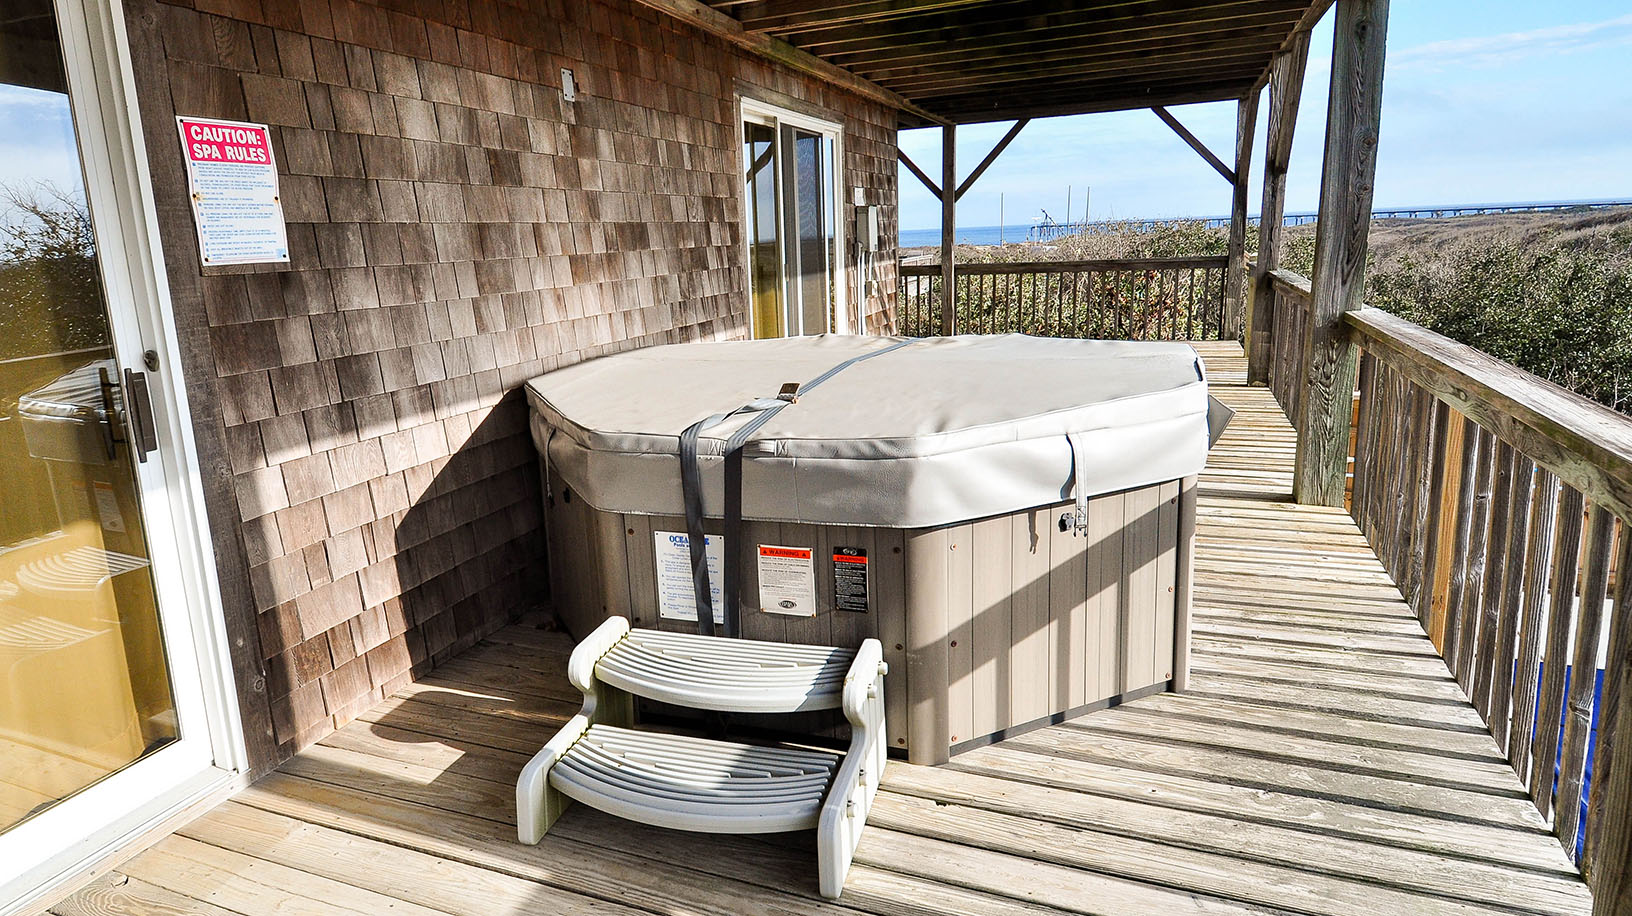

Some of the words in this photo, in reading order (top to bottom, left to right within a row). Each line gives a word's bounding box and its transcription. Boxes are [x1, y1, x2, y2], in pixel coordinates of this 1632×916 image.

[190, 125, 262, 145] CAUTION:
[192, 143, 222, 159] SPA
[224, 145, 267, 162] RULES
